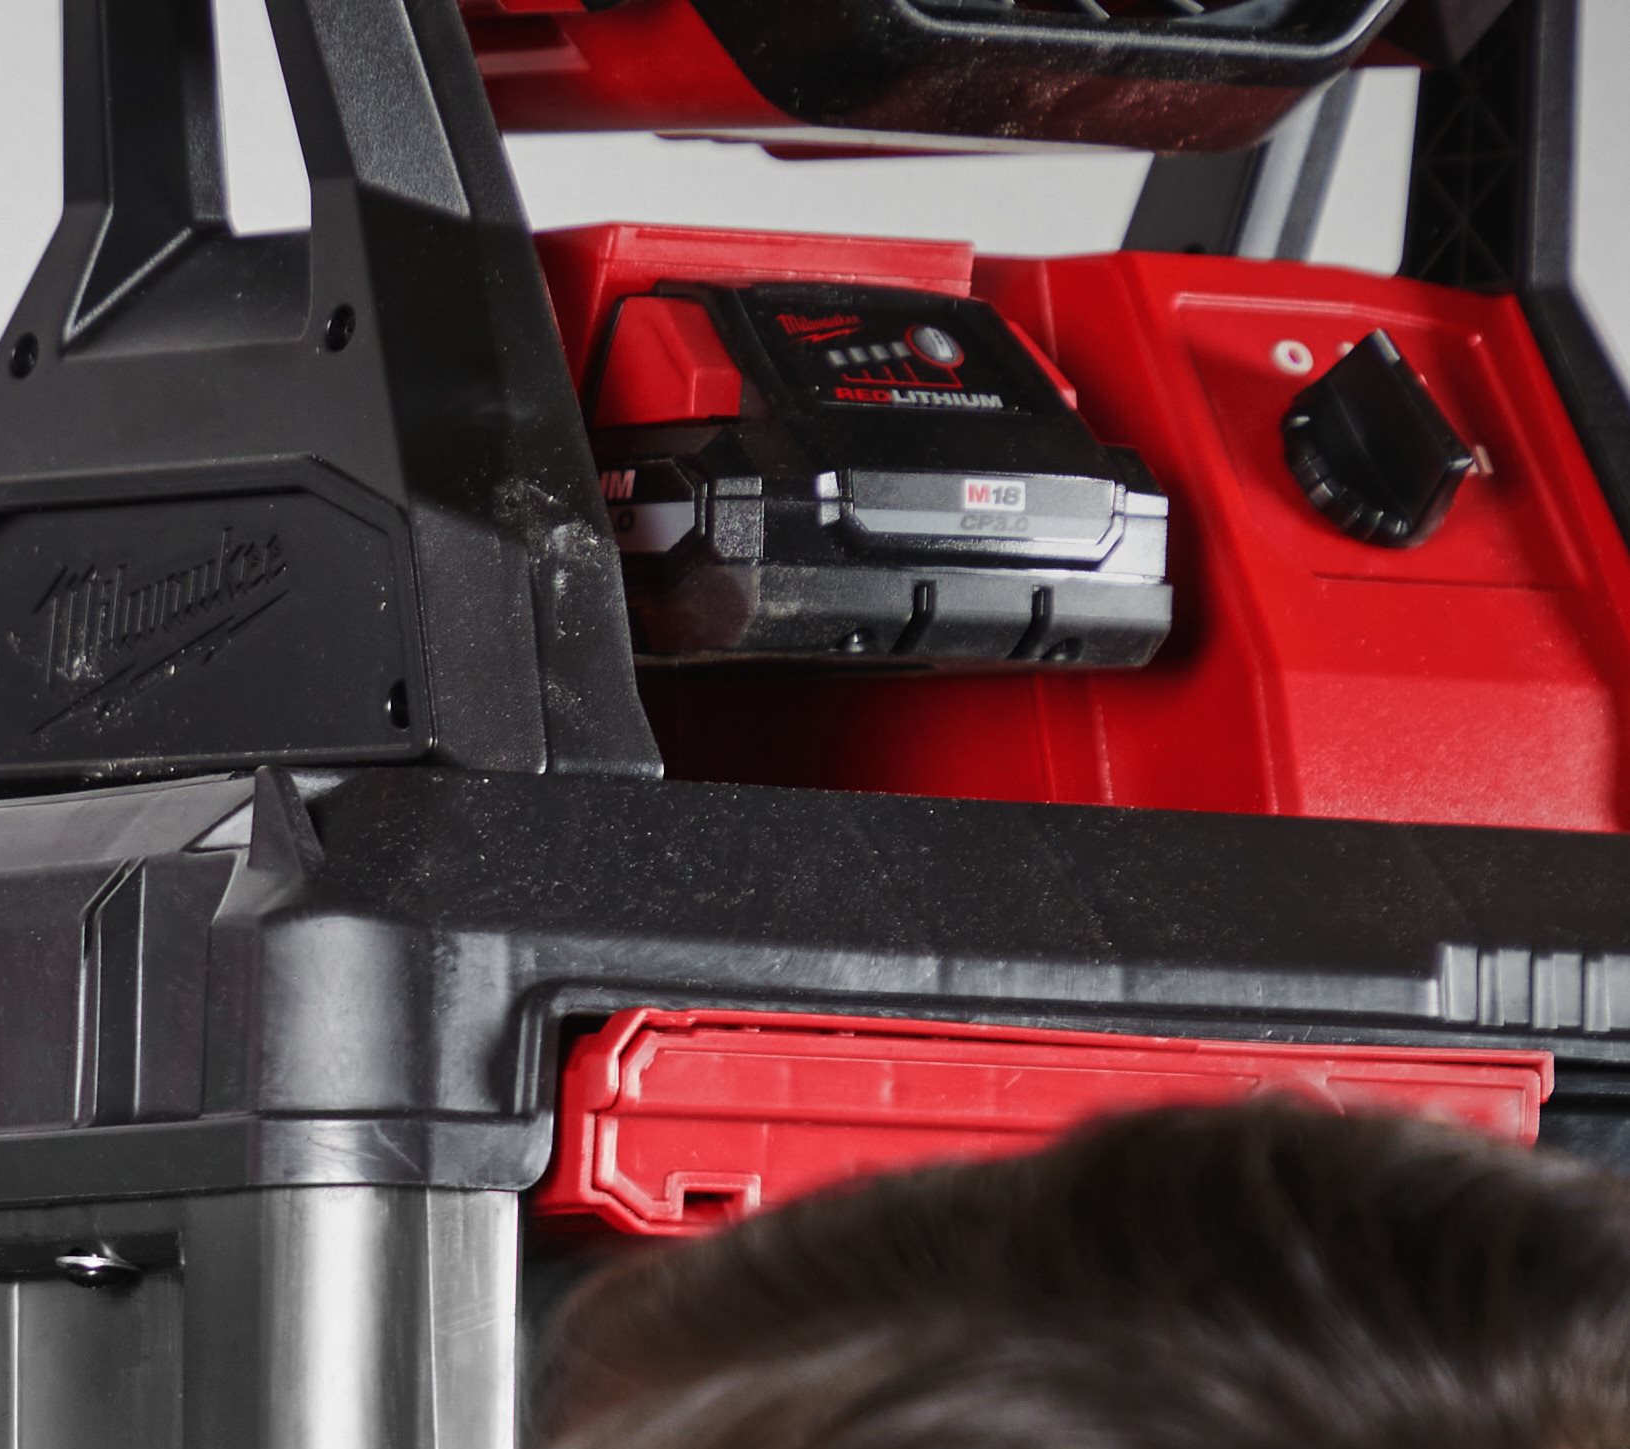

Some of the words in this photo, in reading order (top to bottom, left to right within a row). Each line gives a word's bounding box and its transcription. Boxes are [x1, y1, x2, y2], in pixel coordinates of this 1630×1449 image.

[775, 312, 862, 335] Milwaukee
[834, 386, 1004, 409] REDLITHIUM
[967, 484, 1022, 505] M18
[32, 525, 288, 686] Milwaukee
